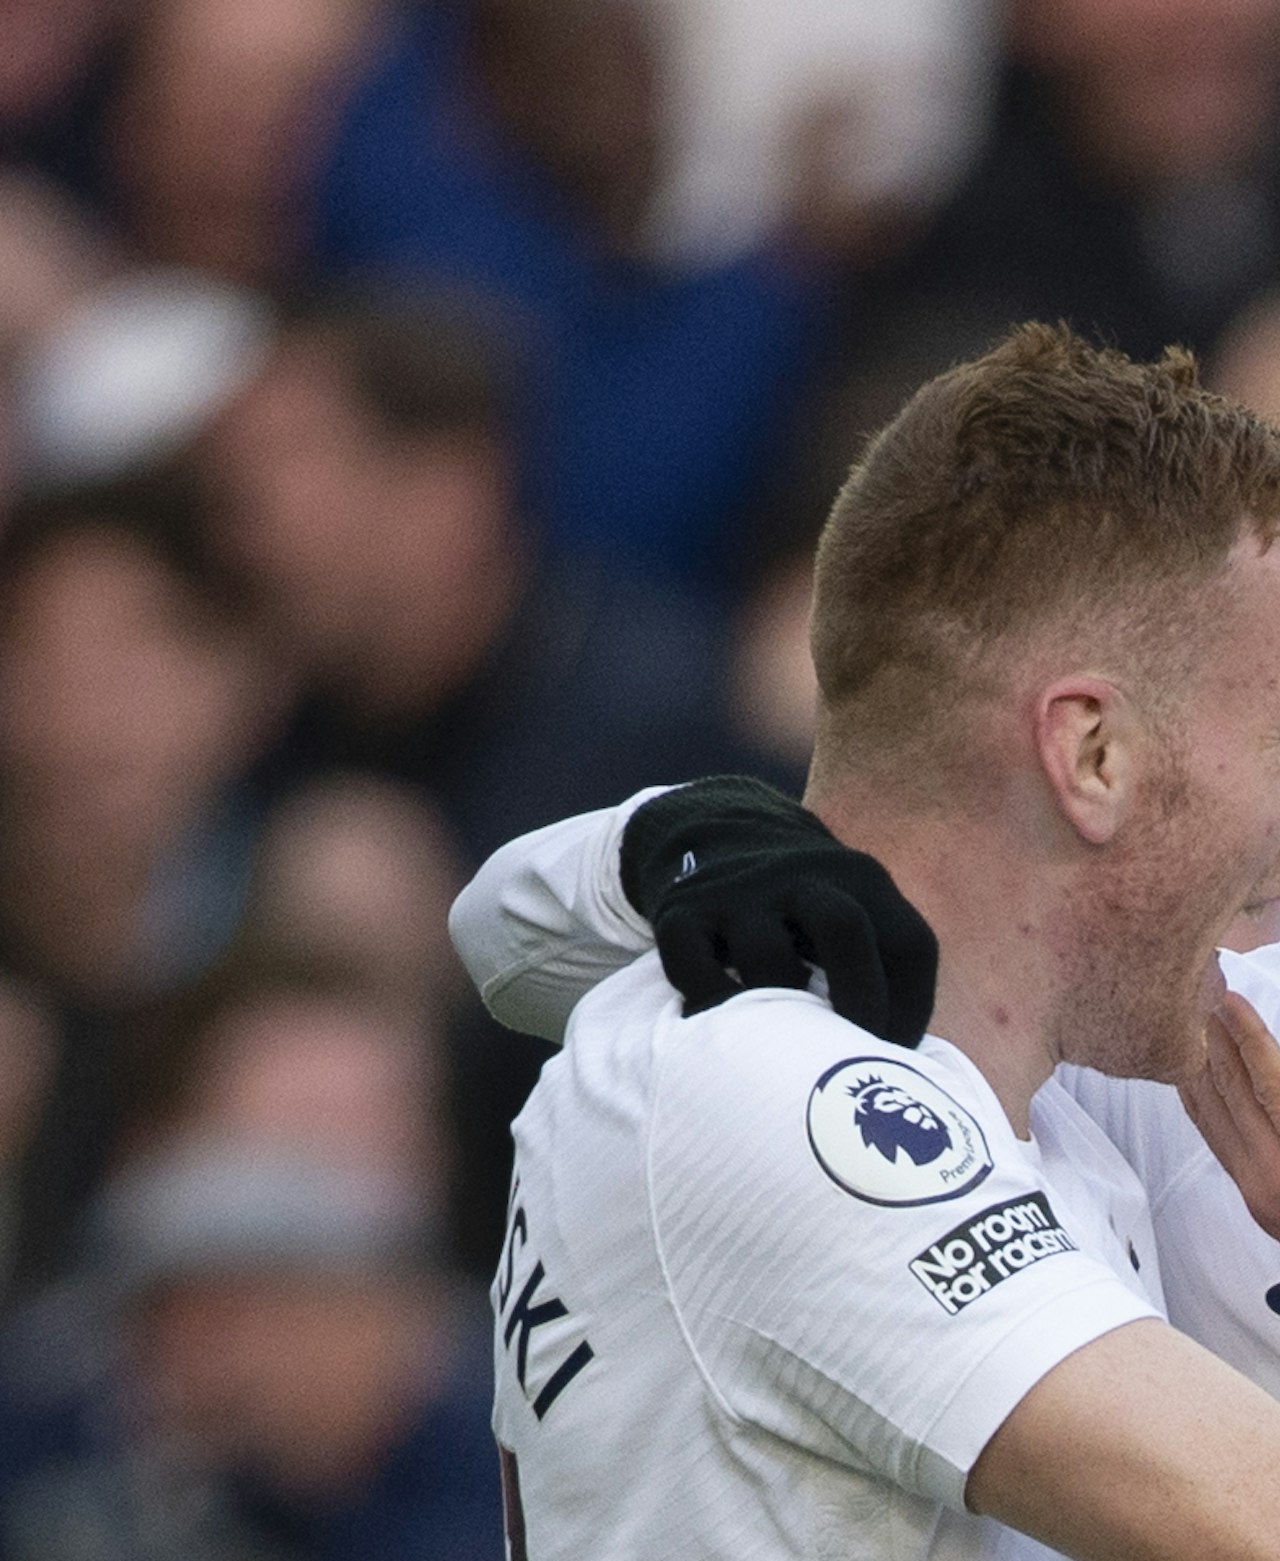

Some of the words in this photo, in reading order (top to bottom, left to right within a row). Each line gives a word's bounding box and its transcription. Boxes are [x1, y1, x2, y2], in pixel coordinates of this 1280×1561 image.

[910, 1244, 975, 1292] No
[968, 1202, 1050, 1252] room
[933, 1261, 991, 1314] for
[499, 1176, 595, 1423] SKI
